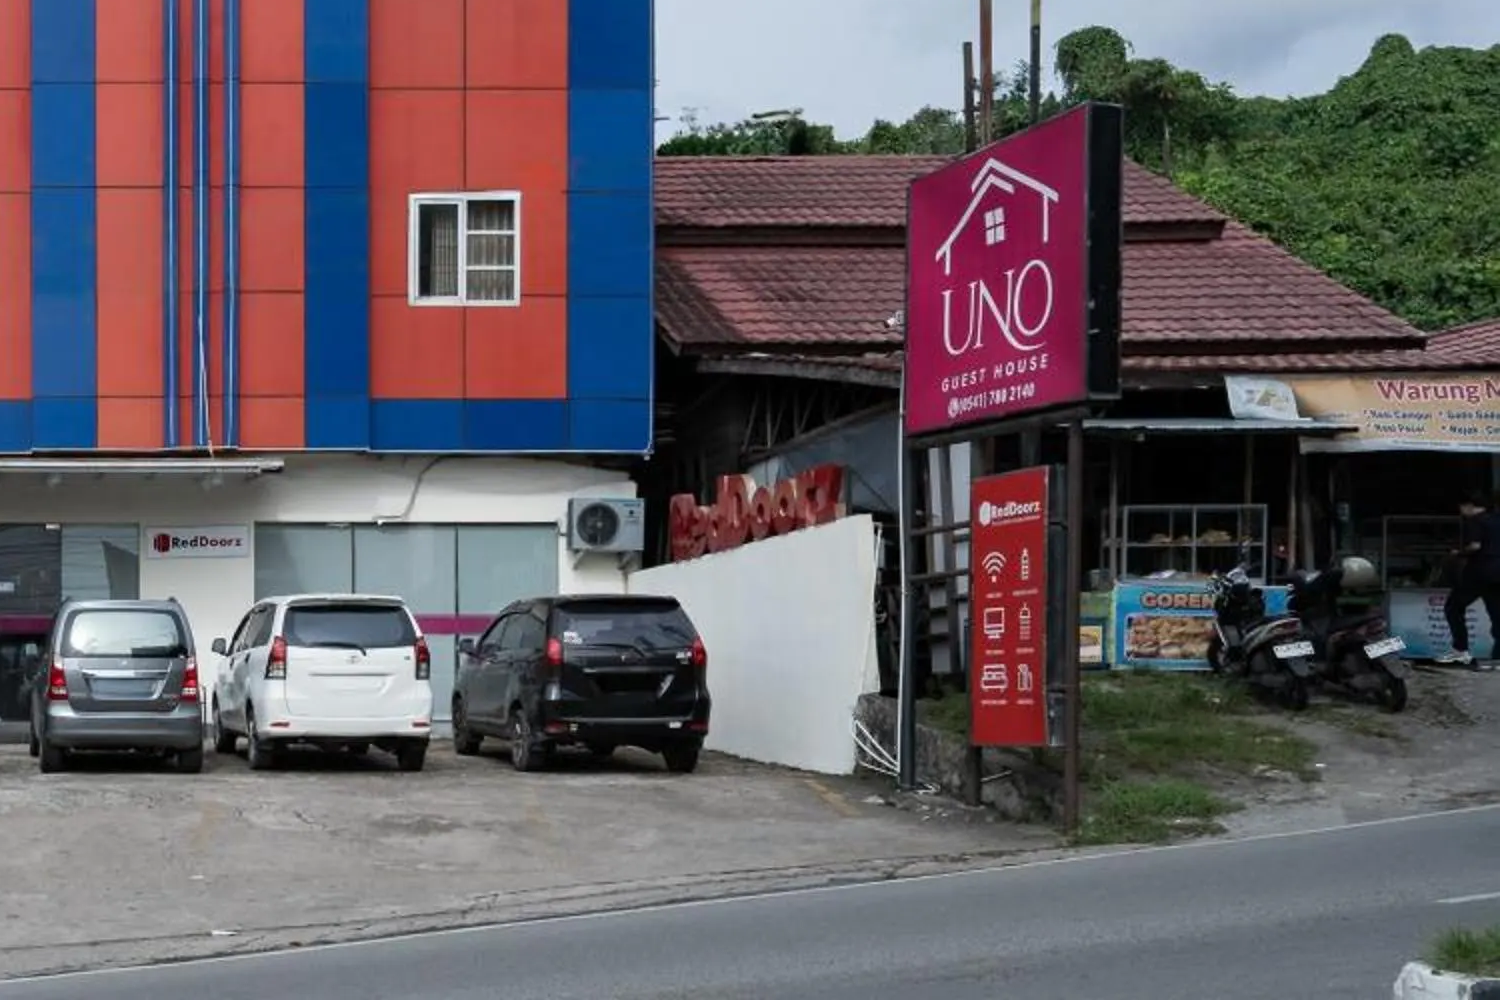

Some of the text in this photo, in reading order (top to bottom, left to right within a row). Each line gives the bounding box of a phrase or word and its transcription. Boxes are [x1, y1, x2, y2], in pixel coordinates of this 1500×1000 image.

[941, 259, 1052, 355] UNO
[941, 353, 1049, 392] GUEST HOUSE
[1377, 379, 1481, 404] Warung
